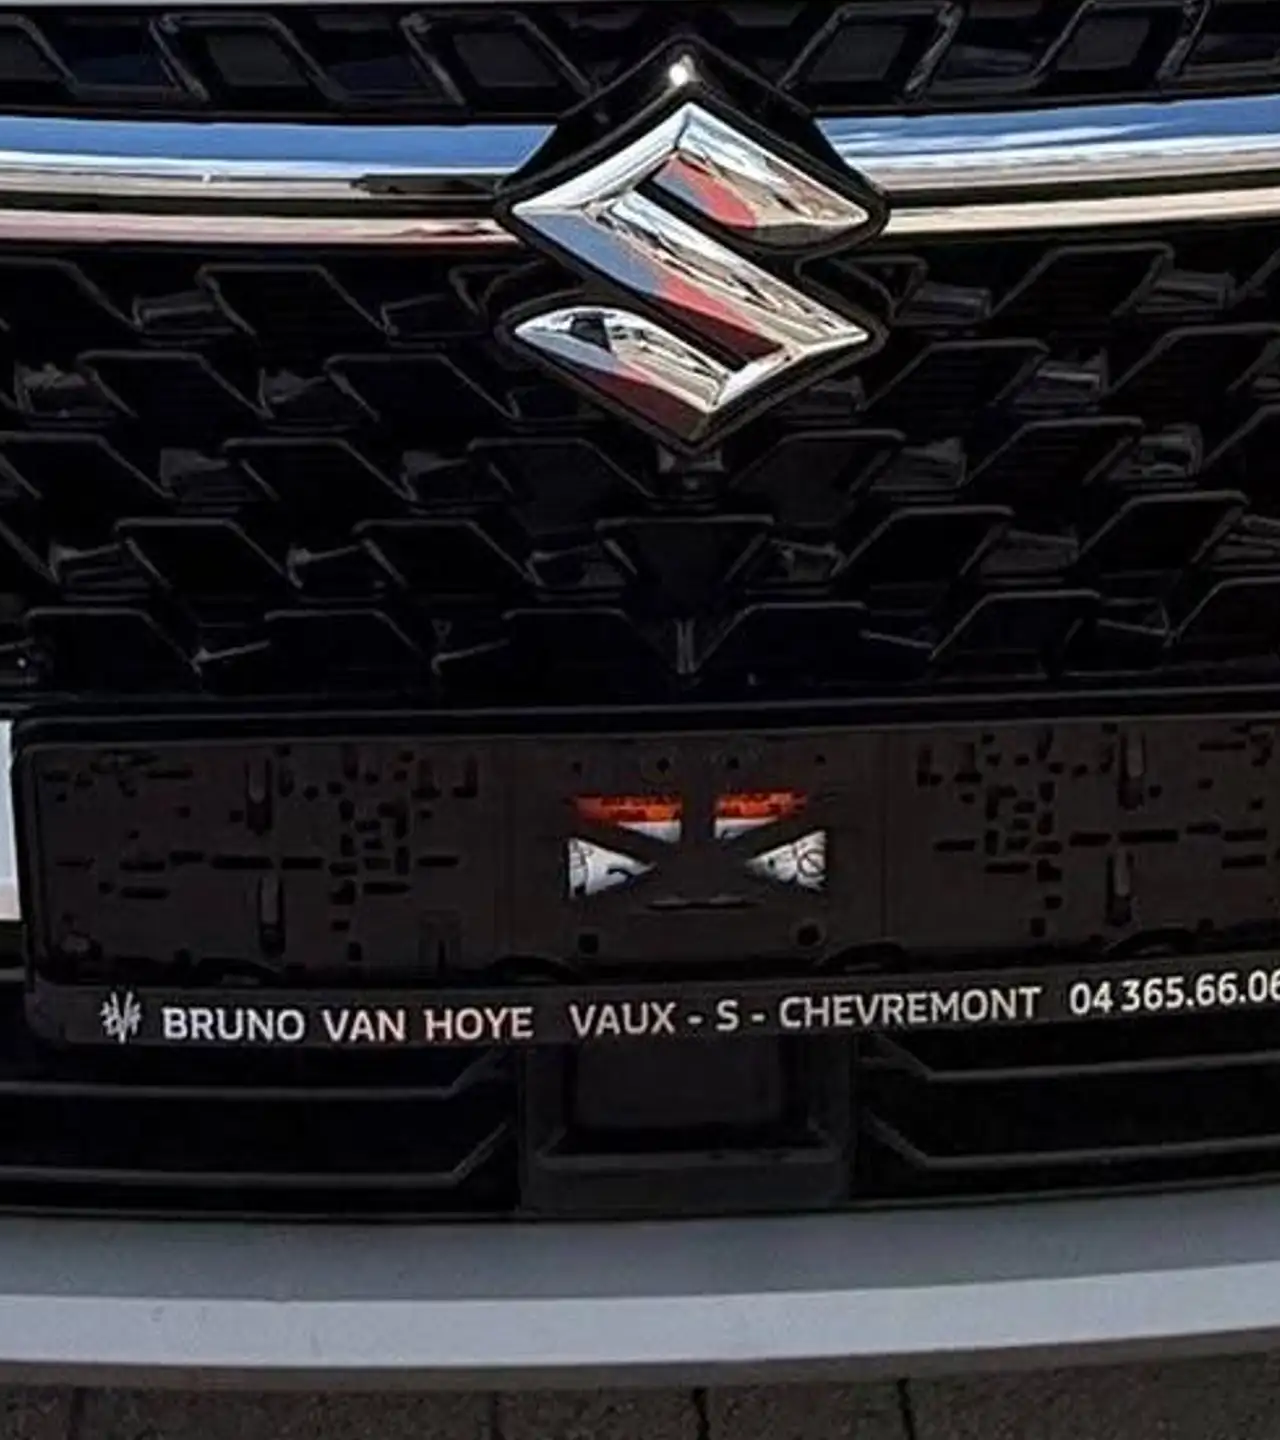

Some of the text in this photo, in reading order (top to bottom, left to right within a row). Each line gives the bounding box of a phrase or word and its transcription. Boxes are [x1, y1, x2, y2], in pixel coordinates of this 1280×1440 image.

[162, 1006, 306, 1041] BRUNO
[321, 1009, 406, 1042] VAN
[424, 1006, 534, 1041] HOYE
[568, 1001, 677, 1038] VAUX
[716, 998, 741, 1033] S
[778, 986, 1042, 1030] CHEVREMONT
[1068, 980, 1114, 1016] 04
